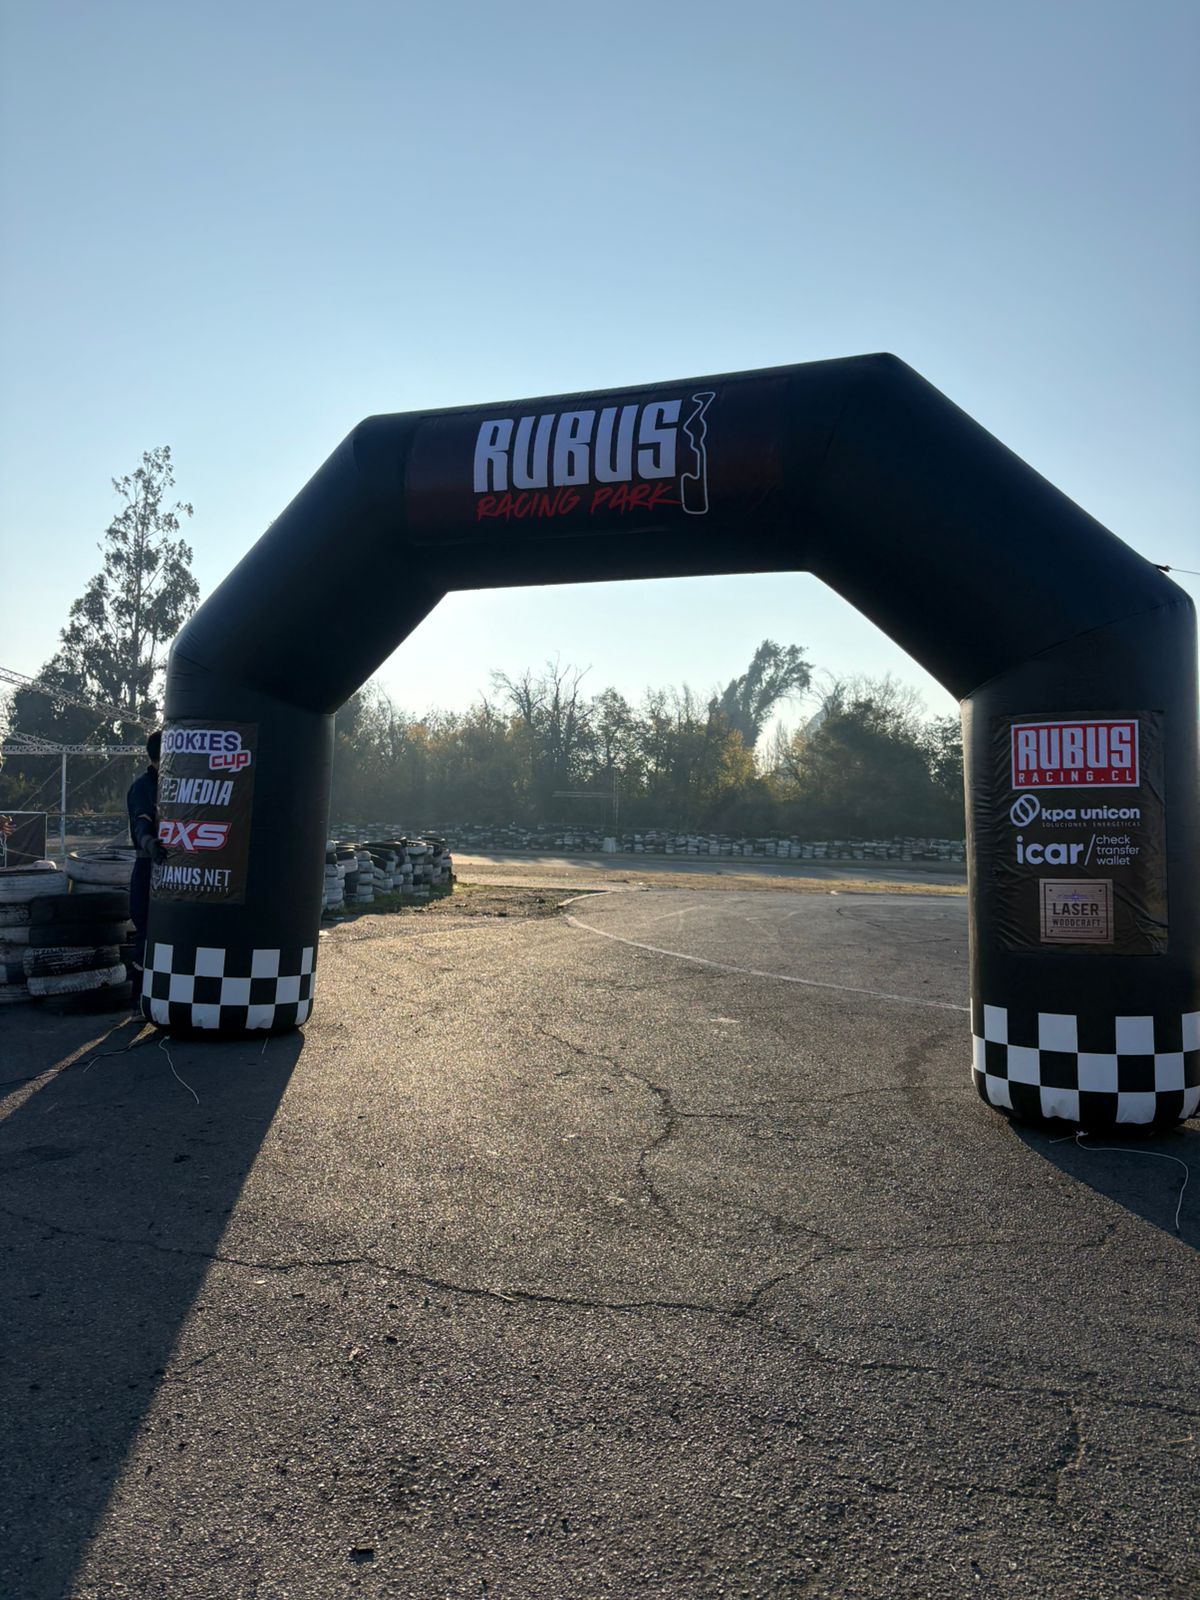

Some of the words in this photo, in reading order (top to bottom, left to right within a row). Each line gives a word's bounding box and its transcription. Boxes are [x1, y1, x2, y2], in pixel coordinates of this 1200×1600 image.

[474, 400, 682, 493] RUBUS
[476, 487, 581, 521] RACING
[591, 482, 683, 514] PARK
[1018, 727, 1131, 771] RUBUS
[1019, 770, 1132, 783] RACING.CL
[177, 779, 234, 806] MEDIA
[1042, 808, 1076, 821] kpa
[1081, 805, 1140, 819] unicon
[1096, 834, 1130, 845] check
[1016, 835, 1084, 865] icar
[1096, 845, 1139, 855] transfer
[1096, 856, 1130, 865] wallet
[204, 869, 231, 887] NET
[1052, 903, 1099, 916] LASER
[1052, 918, 1101, 927] WOODCRAFT
